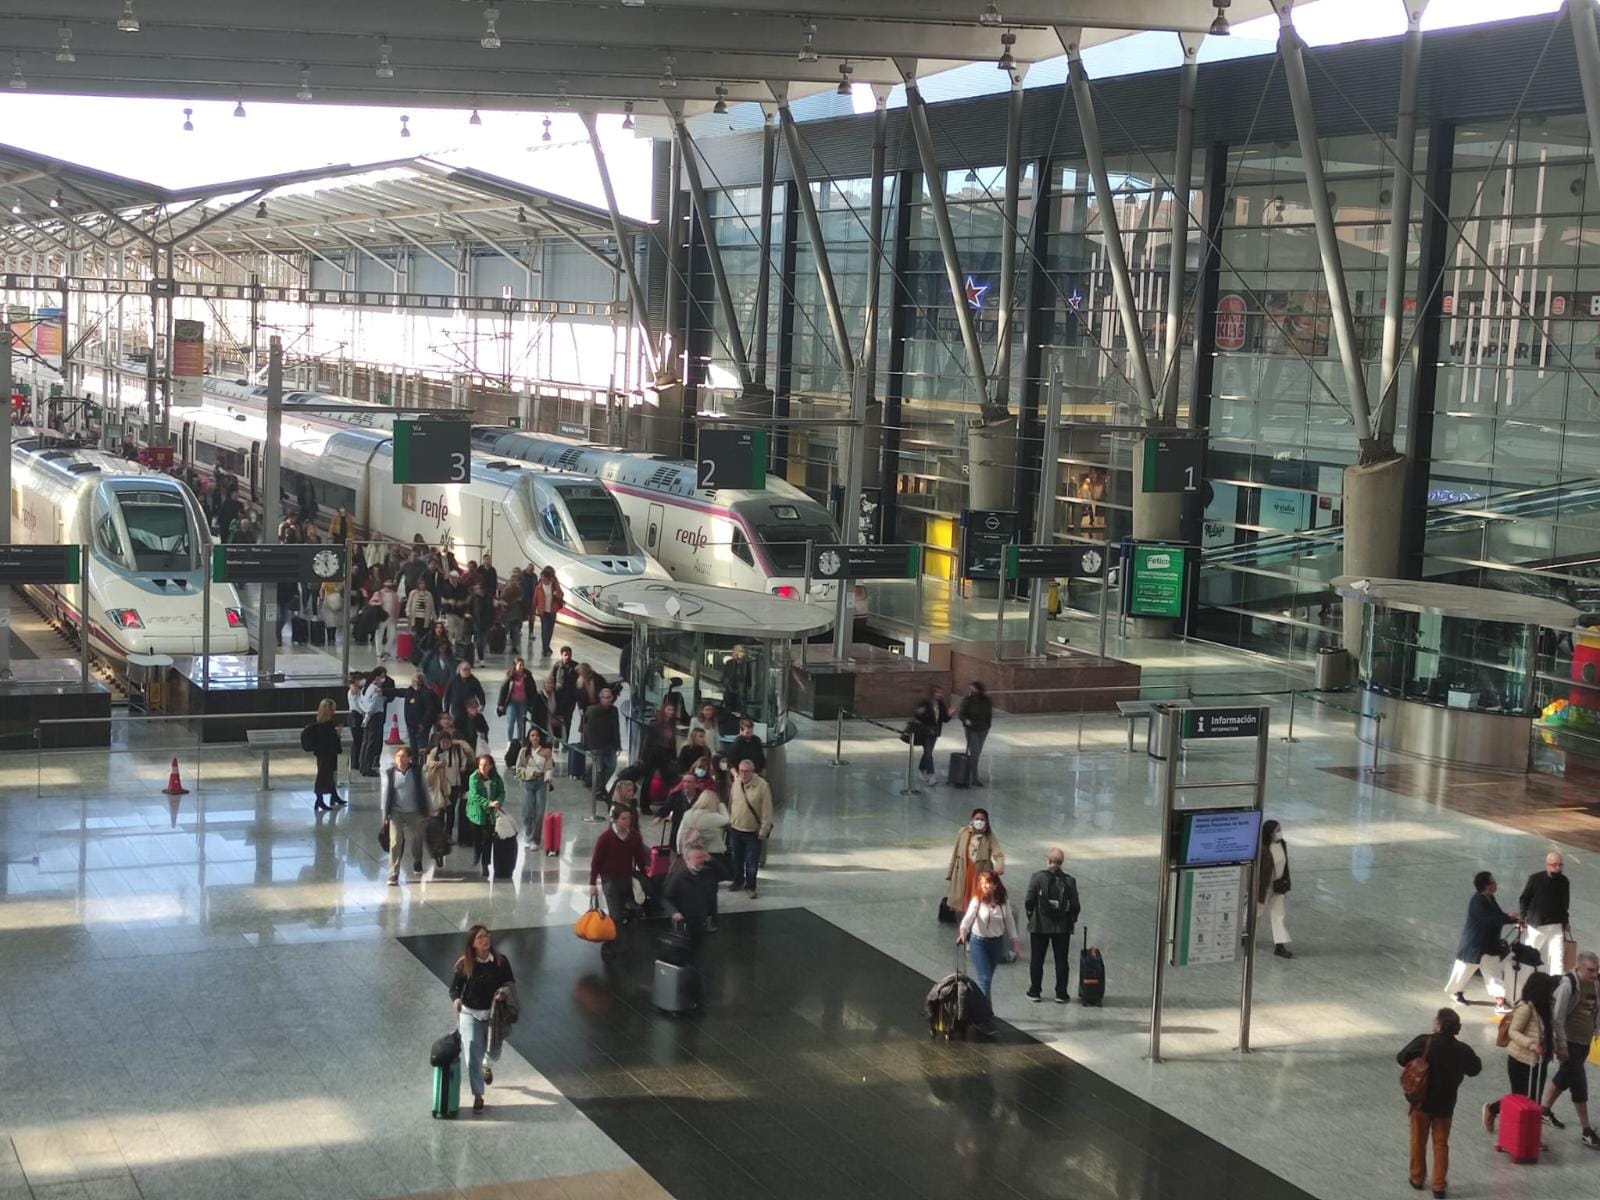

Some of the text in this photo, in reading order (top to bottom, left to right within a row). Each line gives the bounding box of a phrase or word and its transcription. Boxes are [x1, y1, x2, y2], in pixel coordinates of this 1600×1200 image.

[1217, 323, 1244, 338] KING
[450, 452, 466, 480] 3
[701, 459, 716, 486] 2
[1184, 466, 1197, 491] 1
[421, 494, 448, 528] renfe
[675, 525, 708, 554] renfe
[1211, 714, 1257, 725] Información
